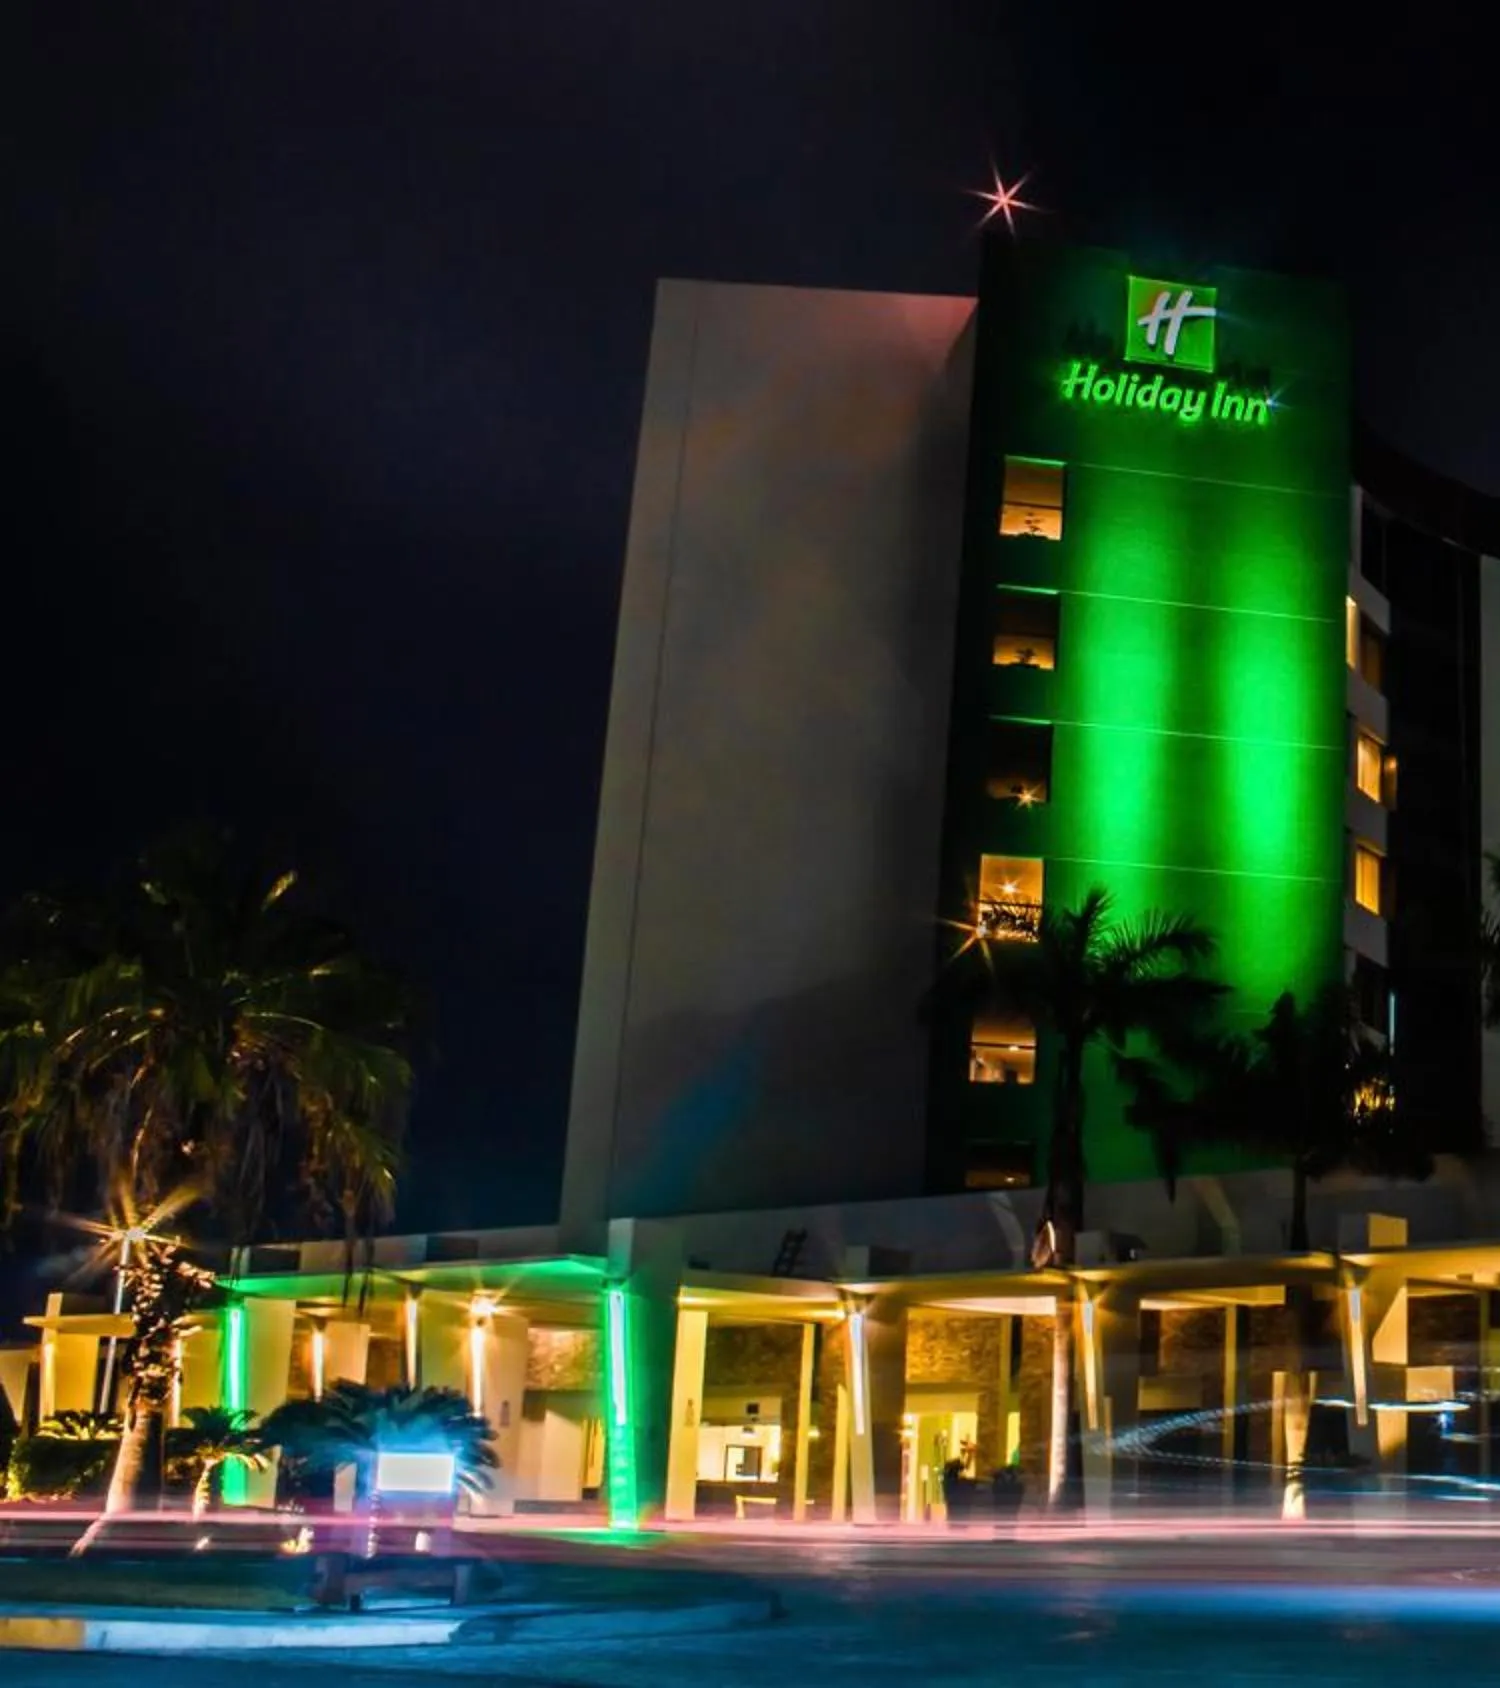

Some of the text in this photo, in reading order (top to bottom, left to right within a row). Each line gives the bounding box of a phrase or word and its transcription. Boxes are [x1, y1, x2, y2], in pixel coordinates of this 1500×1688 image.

[1138, 291, 1216, 355] H
[1062, 362, 1268, 424] Holiday Inn
